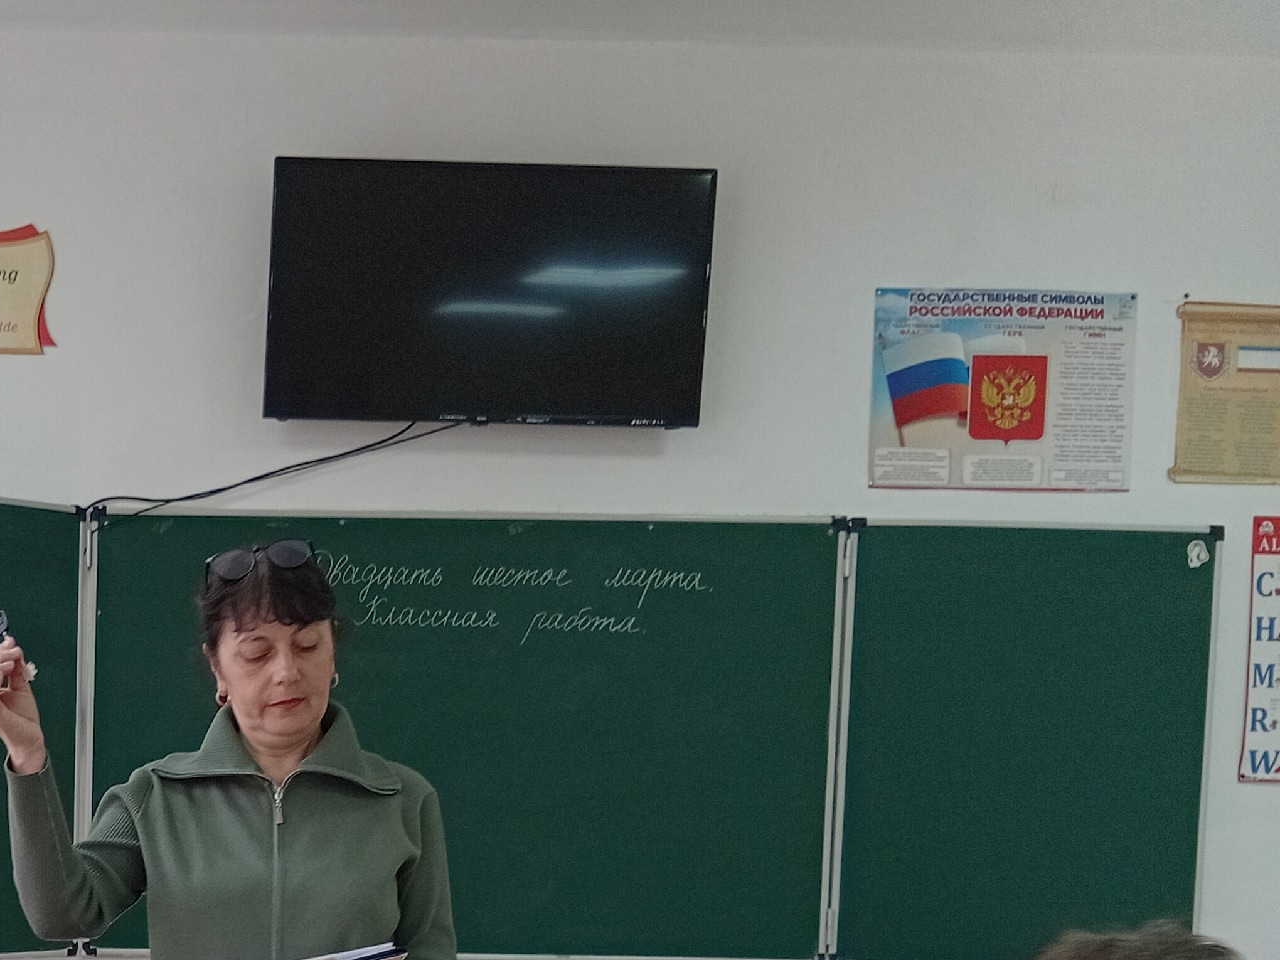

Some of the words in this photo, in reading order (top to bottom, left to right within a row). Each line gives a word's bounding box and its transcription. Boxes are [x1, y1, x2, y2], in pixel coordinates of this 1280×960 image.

[909, 291, 1038, 304] ГОСУДАРСТВЕННЫЕ
[1041, 293, 1105, 305] СИМВОЛЫ
[909, 304, 1014, 317] РОССИЙСКОЙ
[1016, 306, 1105, 320] ФЕДЕРАЦИИ
[472, 565, 572, 587] шестое
[605, 565, 714, 608] марта.
[354, 595, 499, 627] Классная
